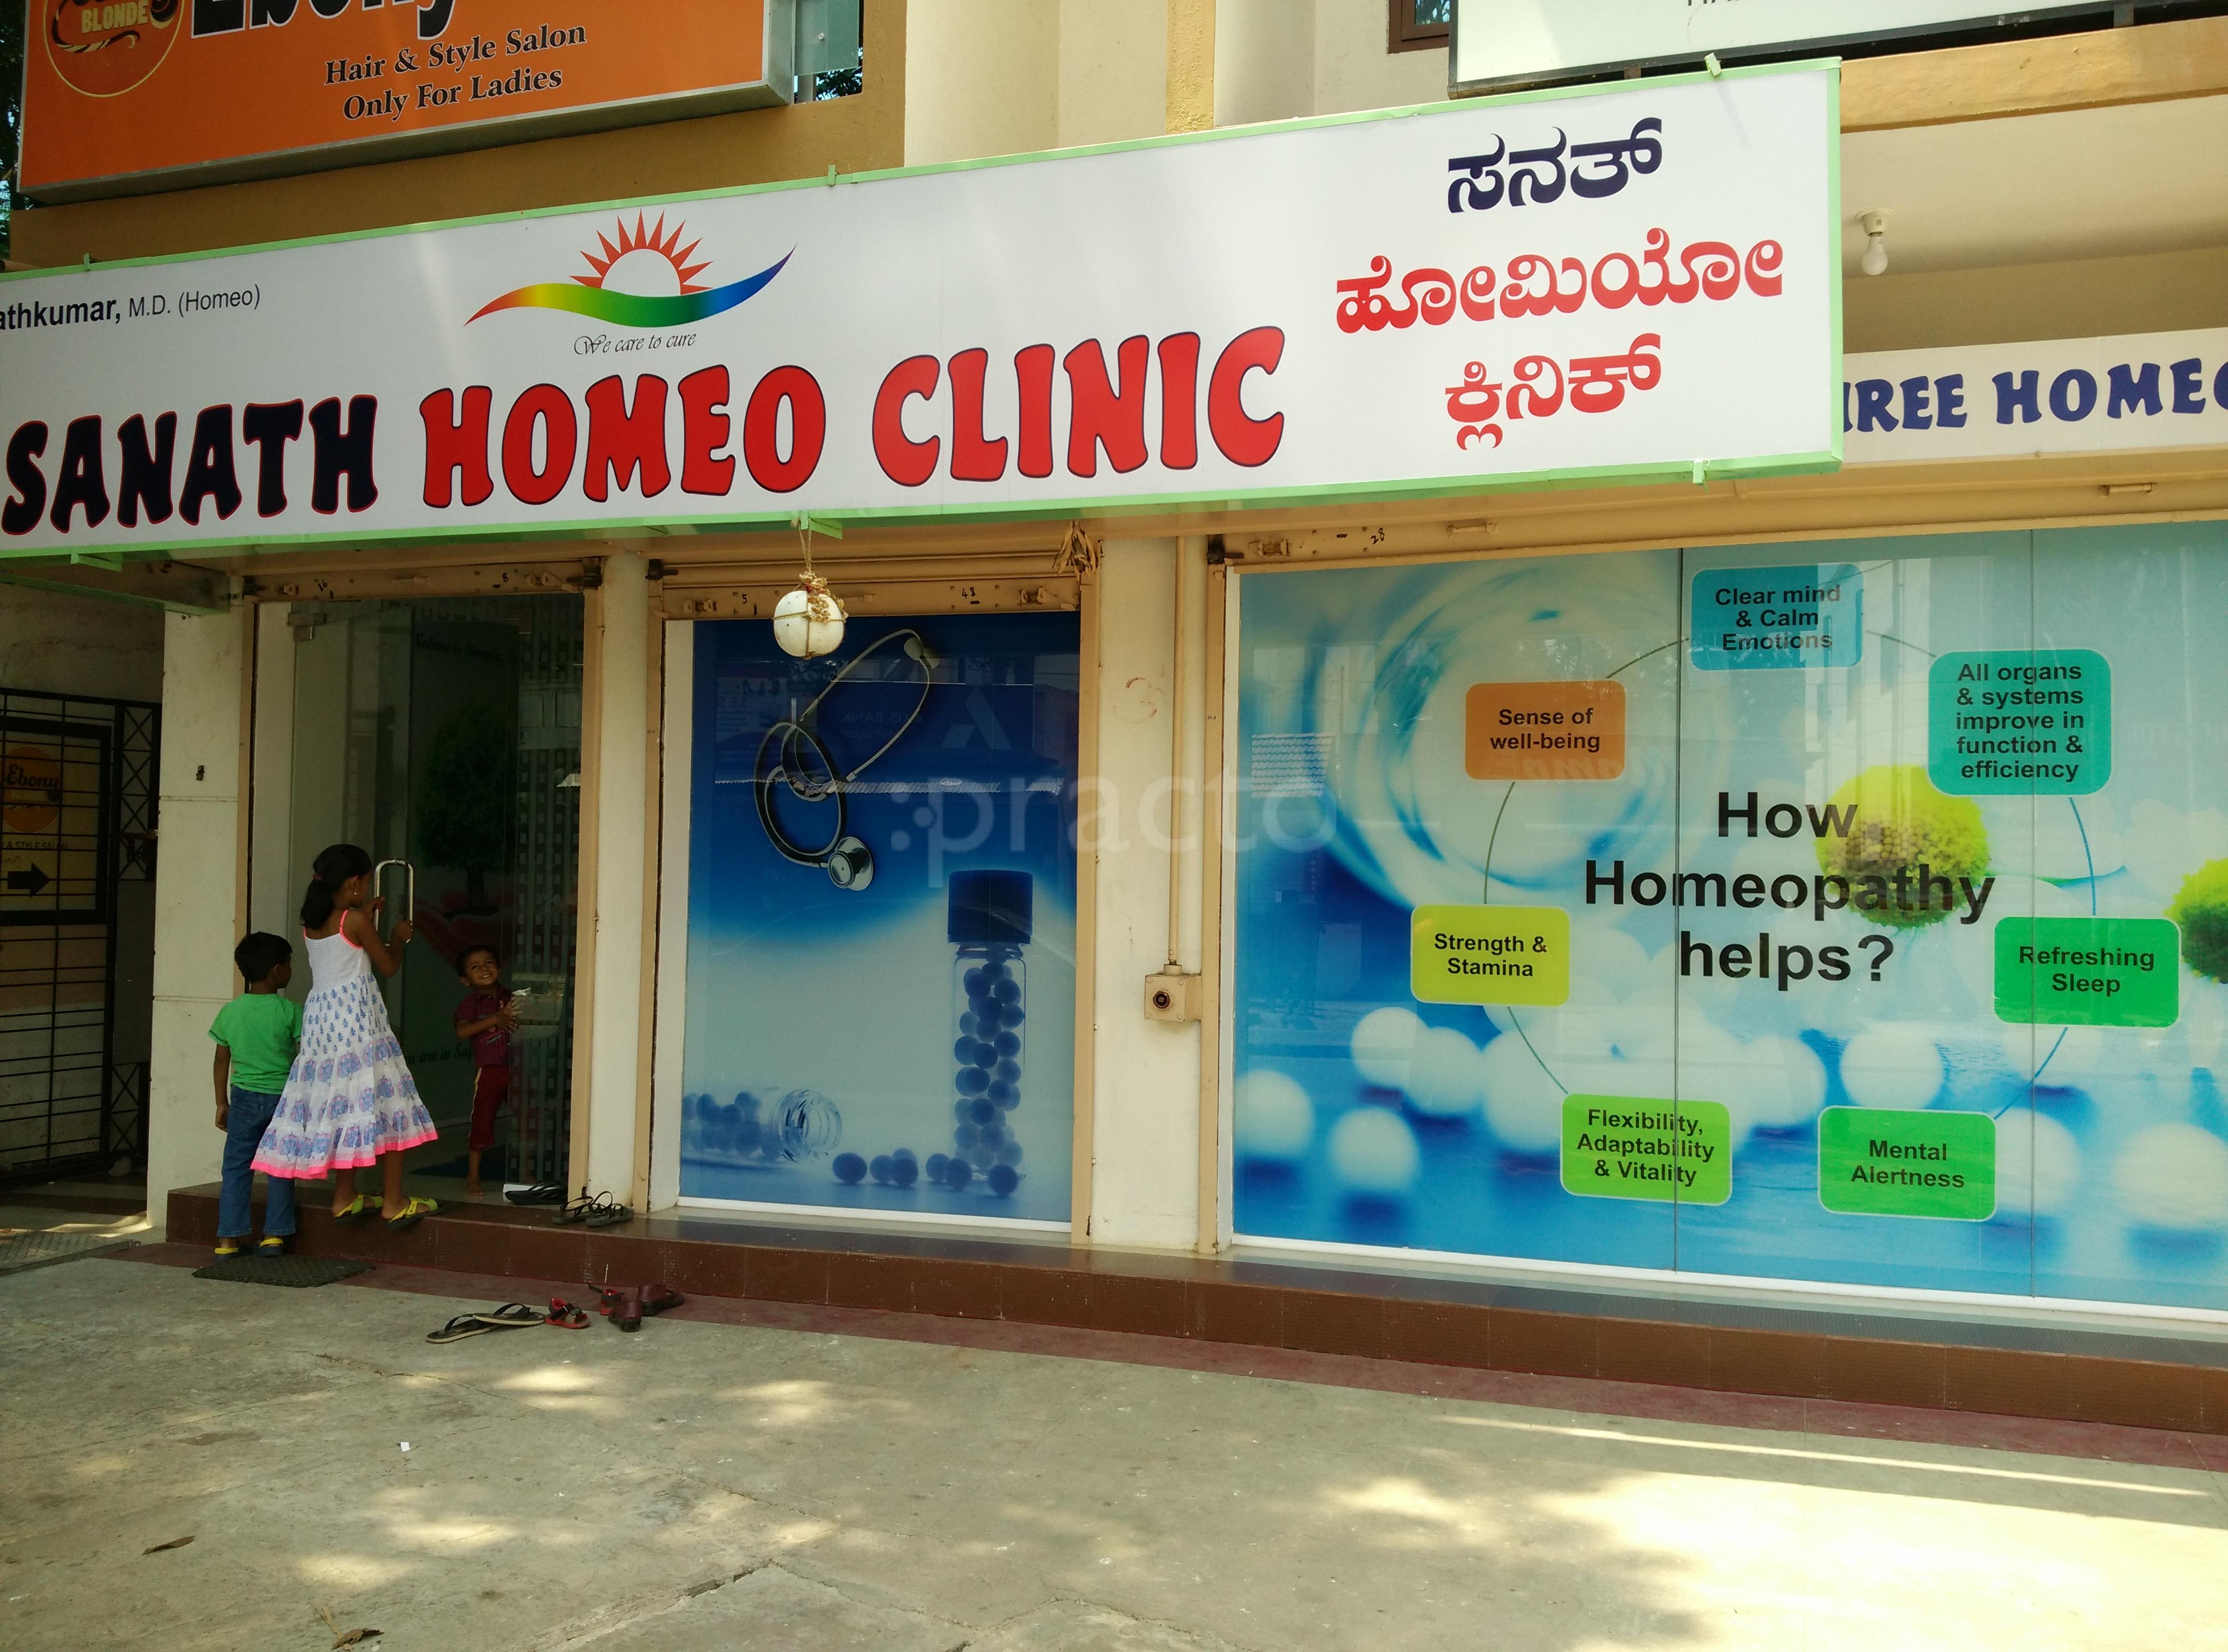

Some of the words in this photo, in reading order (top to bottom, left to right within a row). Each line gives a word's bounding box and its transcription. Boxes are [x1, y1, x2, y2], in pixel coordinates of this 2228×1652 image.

[82, 2, 148, 33] BLONDE
[325, 55, 386, 85] Hair
[394, 48, 420, 74] &
[428, 35, 496, 72] Style
[505, 23, 587, 55] Salon
[343, 89, 409, 121] Only
[416, 83, 462, 109] For
[469, 67, 563, 101] Ladies
[1448, 117, 1663, 213] ಸನತ್
[1336, 227, 1784, 334] ಹೋಮಿಯೋ
[129, 294, 171, 318] M.D.
[178, 284, 260, 318] (Homeo)
[574, 334, 611, 355] We
[615, 337, 645, 353] care
[648, 335, 662, 349] to
[666, 333, 697, 348] cure
[1444, 333, 1661, 451] ಕ್ಲಿನಿಕ್
[1844, 372, 1968, 433] REE
[1, 394, 379, 535] SANATH
[419, 364, 826, 509] HOMEO
[872, 325, 1286, 487] CLINIC
[1370, 527, 1386, 545] 28
[502, 572, 508, 583] 8
[742, 594, 748, 605] 5
[1715, 587, 1776, 606] Clear
[1783, 585, 1841, 603] mind
[1736, 612, 1753, 628] &
[1760, 609, 1819, 627] Calm
[1722, 632, 1834, 651] Emotions
[1957, 663, 1989, 681] All
[1997, 664, 2082, 684] organs
[1957, 688, 1974, 706] &
[1981, 689, 2083, 710] systems
[1498, 707, 1565, 726] Sense
[1571, 707, 1594, 725] of
[1956, 712, 2054, 734] improve
[2062, 711, 2085, 729] in
[1490, 732, 1601, 754] well-being
[1956, 736, 2057, 754] function
[2066, 736, 2084, 754] &
[1960, 760, 2080, 783] efficiency
[5, 764, 62, 803] Ebony
[1718, 791, 1858, 838] How
[1585, 859, 1996, 924] Homeopathy
[1433, 933, 1525, 956] Strength
[1532, 936, 1548, 953] &
[1447, 957, 1533, 977] Stamina
[1679, 930, 1894, 992] helps?
[2019, 946, 2155, 969] Refreshing
[2052, 973, 2121, 996] Sleep
[440, 1048, 450, 1060] in
[1587, 1109, 1703, 1136] Flexibility,
[1577, 1133, 1714, 1162] Adaptability
[1869, 1139, 1947, 1162] Mental
[1594, 1160, 1610, 1178] &
[1617, 1161, 1697, 1187] Vitality
[1851, 1165, 1964, 1189] Alertness
